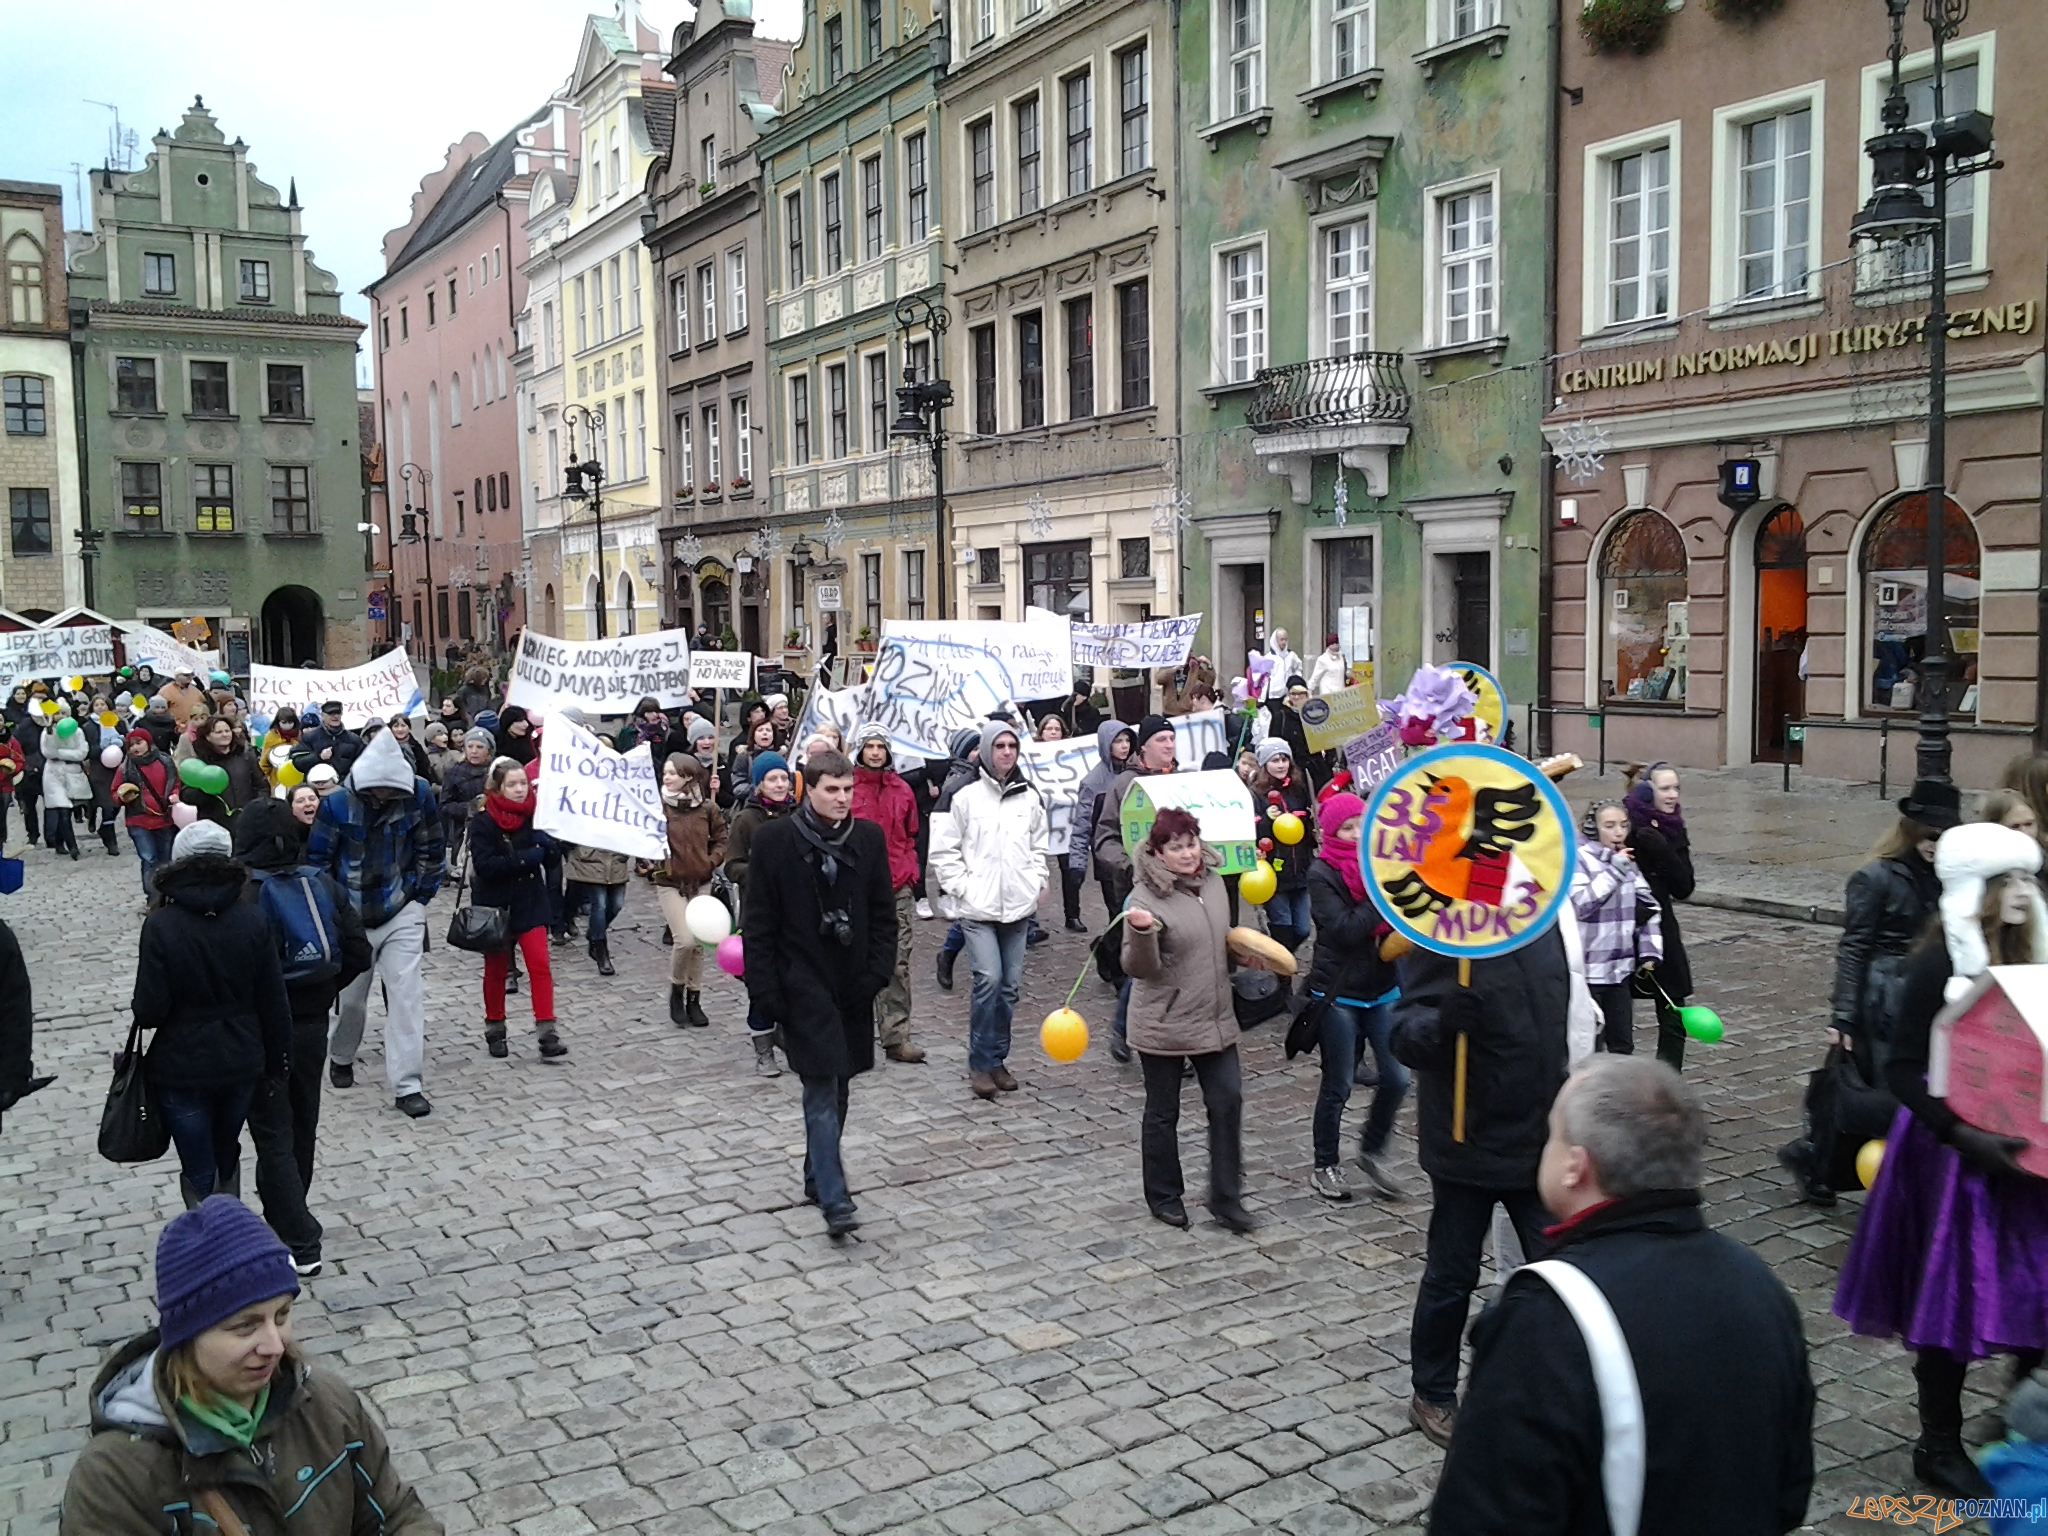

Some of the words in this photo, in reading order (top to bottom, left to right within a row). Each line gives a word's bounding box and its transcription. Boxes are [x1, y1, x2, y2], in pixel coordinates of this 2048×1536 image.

[1560, 357, 1664, 394] CENTRUM
[1671, 333, 1818, 378] INFORMACJI
[1829, 300, 2037, 357] TURYSTCZNEJ
[553, 672, 607, 702] MNĄ
[696, 667, 713, 680] NO
[714, 667, 744, 681] NAME
[1376, 786, 1450, 836] 35
[1373, 827, 1435, 865] LAT
